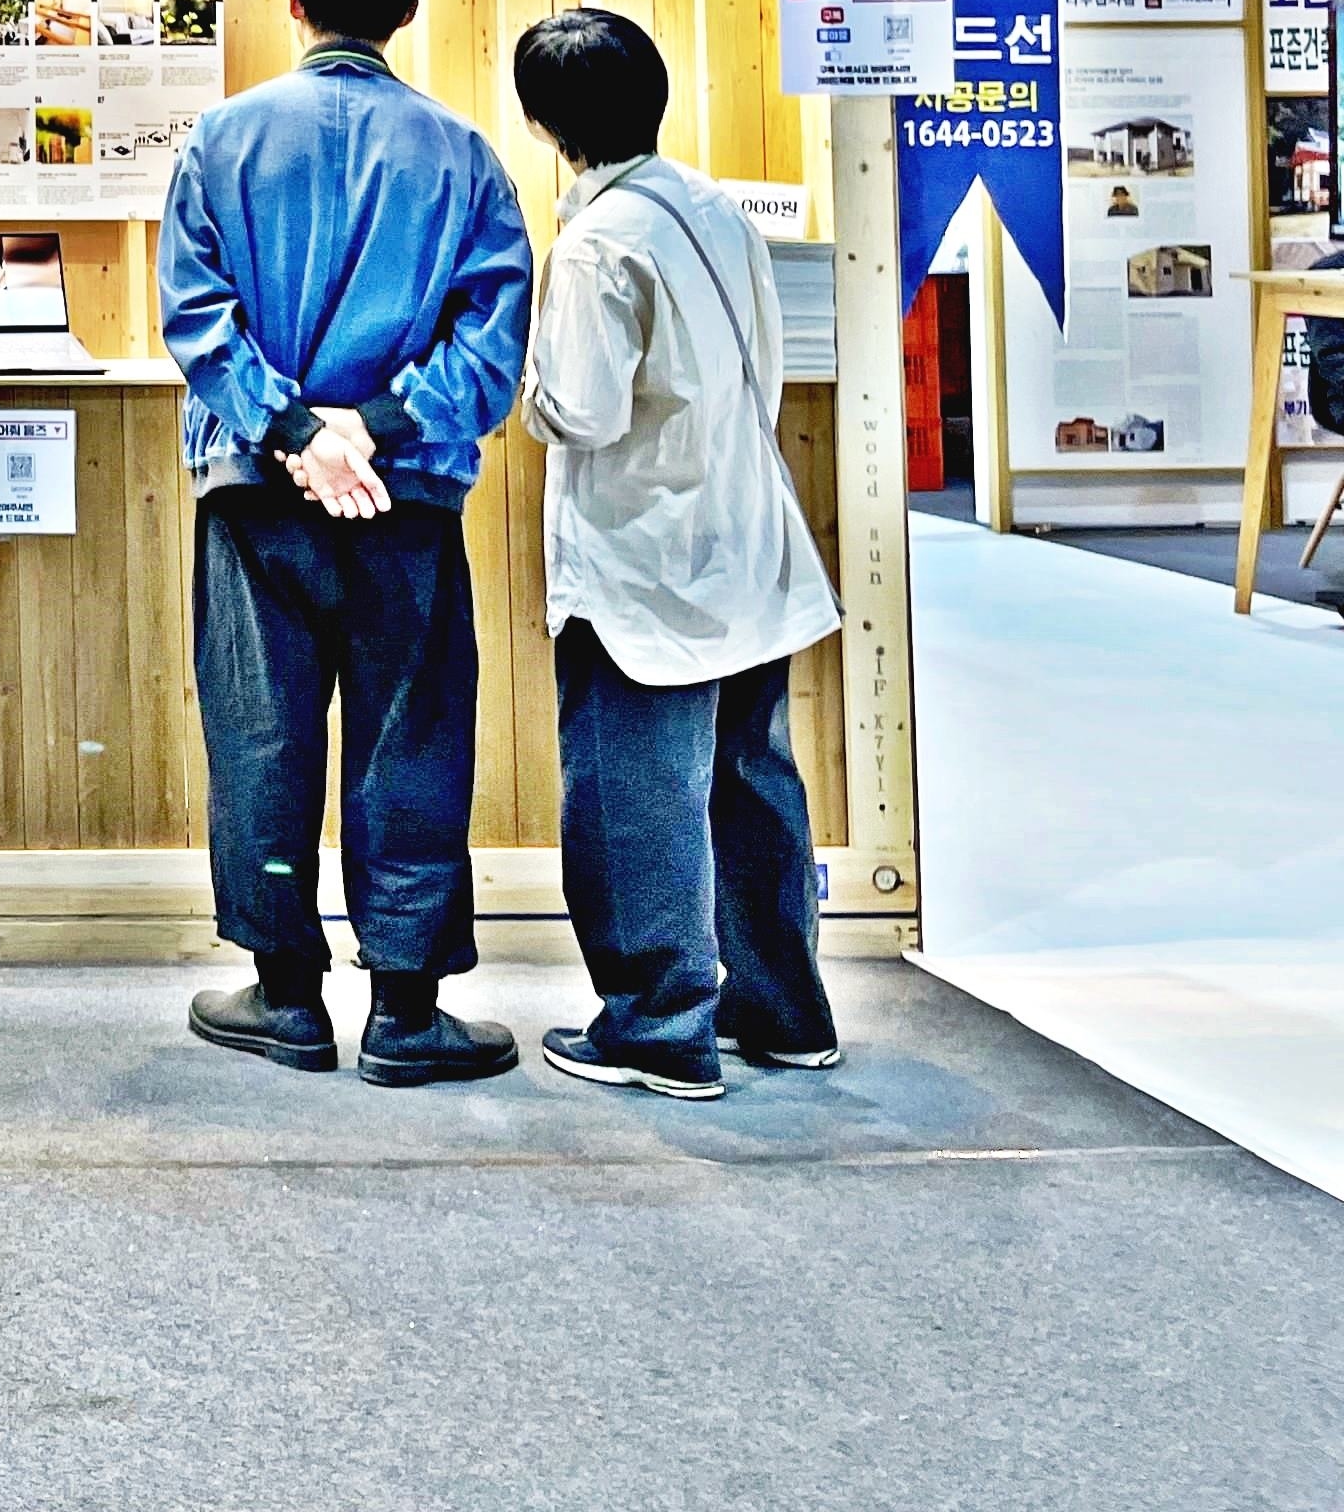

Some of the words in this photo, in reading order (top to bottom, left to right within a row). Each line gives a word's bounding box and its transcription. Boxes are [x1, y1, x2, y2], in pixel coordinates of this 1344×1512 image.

[954, 13, 1052, 65] 드선
[914, 81, 1038, 113] 시공문의
[903, 119, 1054, 148] 1644-0523
[863, 418, 879, 499] wood
[868, 528, 882, 586] sun
